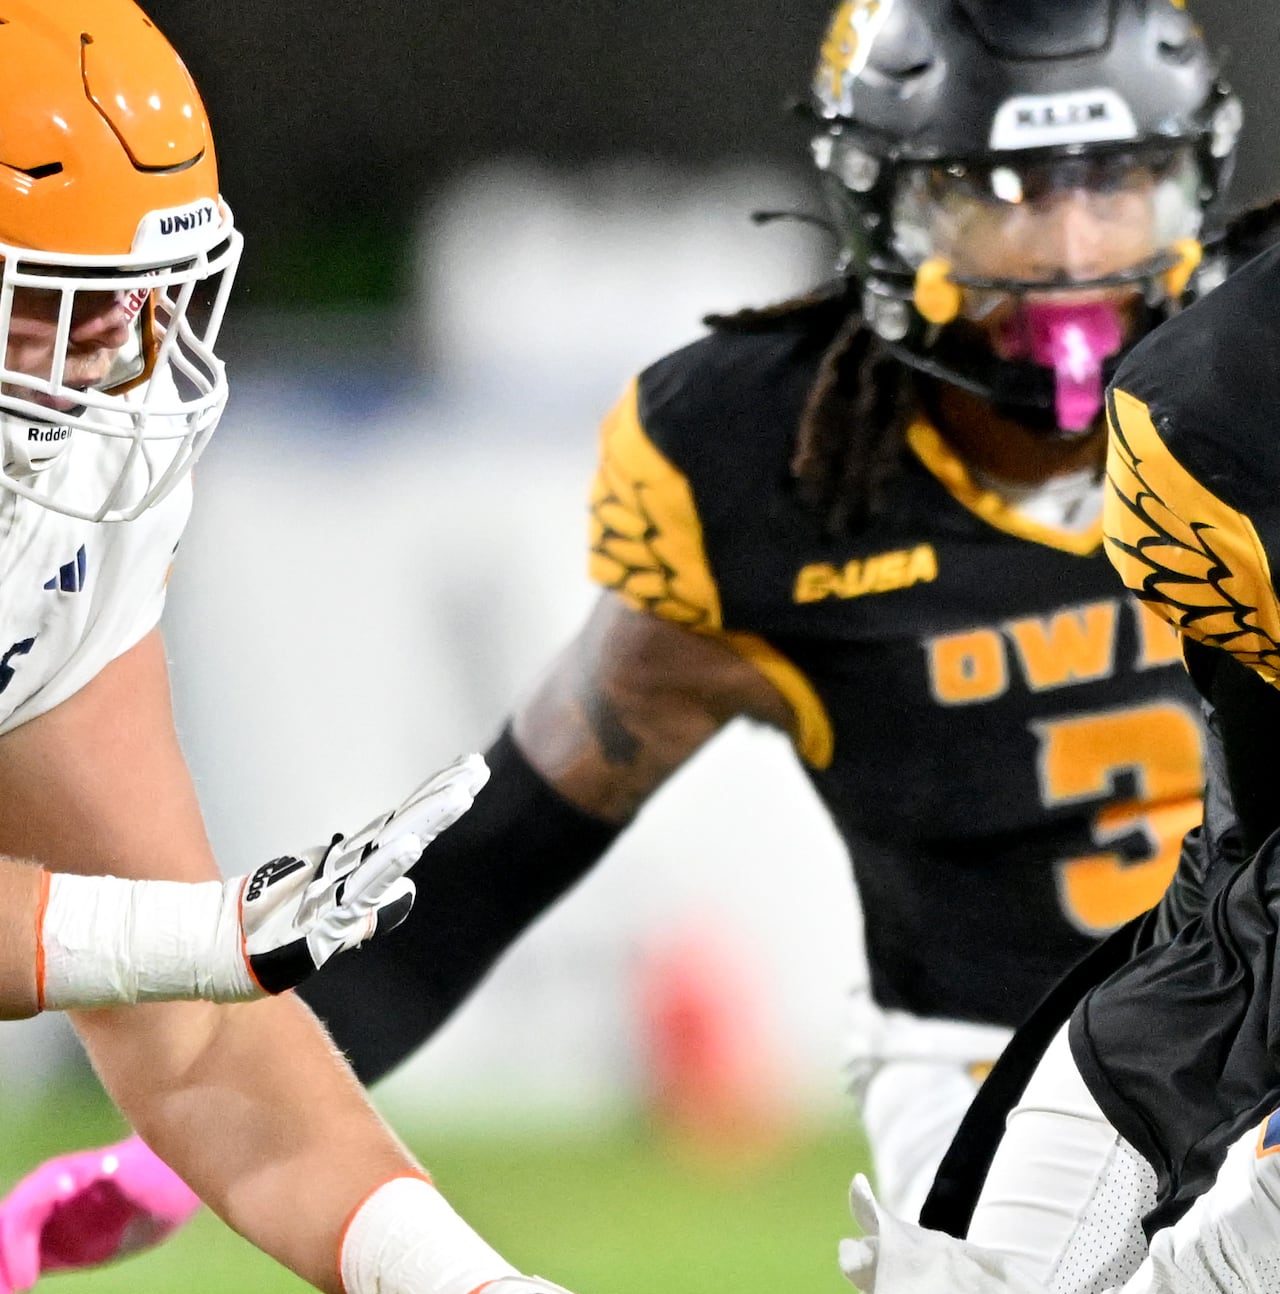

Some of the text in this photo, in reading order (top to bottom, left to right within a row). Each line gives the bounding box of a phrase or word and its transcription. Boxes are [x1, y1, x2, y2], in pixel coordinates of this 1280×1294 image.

[159, 206, 213, 236] UNITY
[922, 596, 1185, 708] OWL
[1026, 698, 1207, 940] 3
